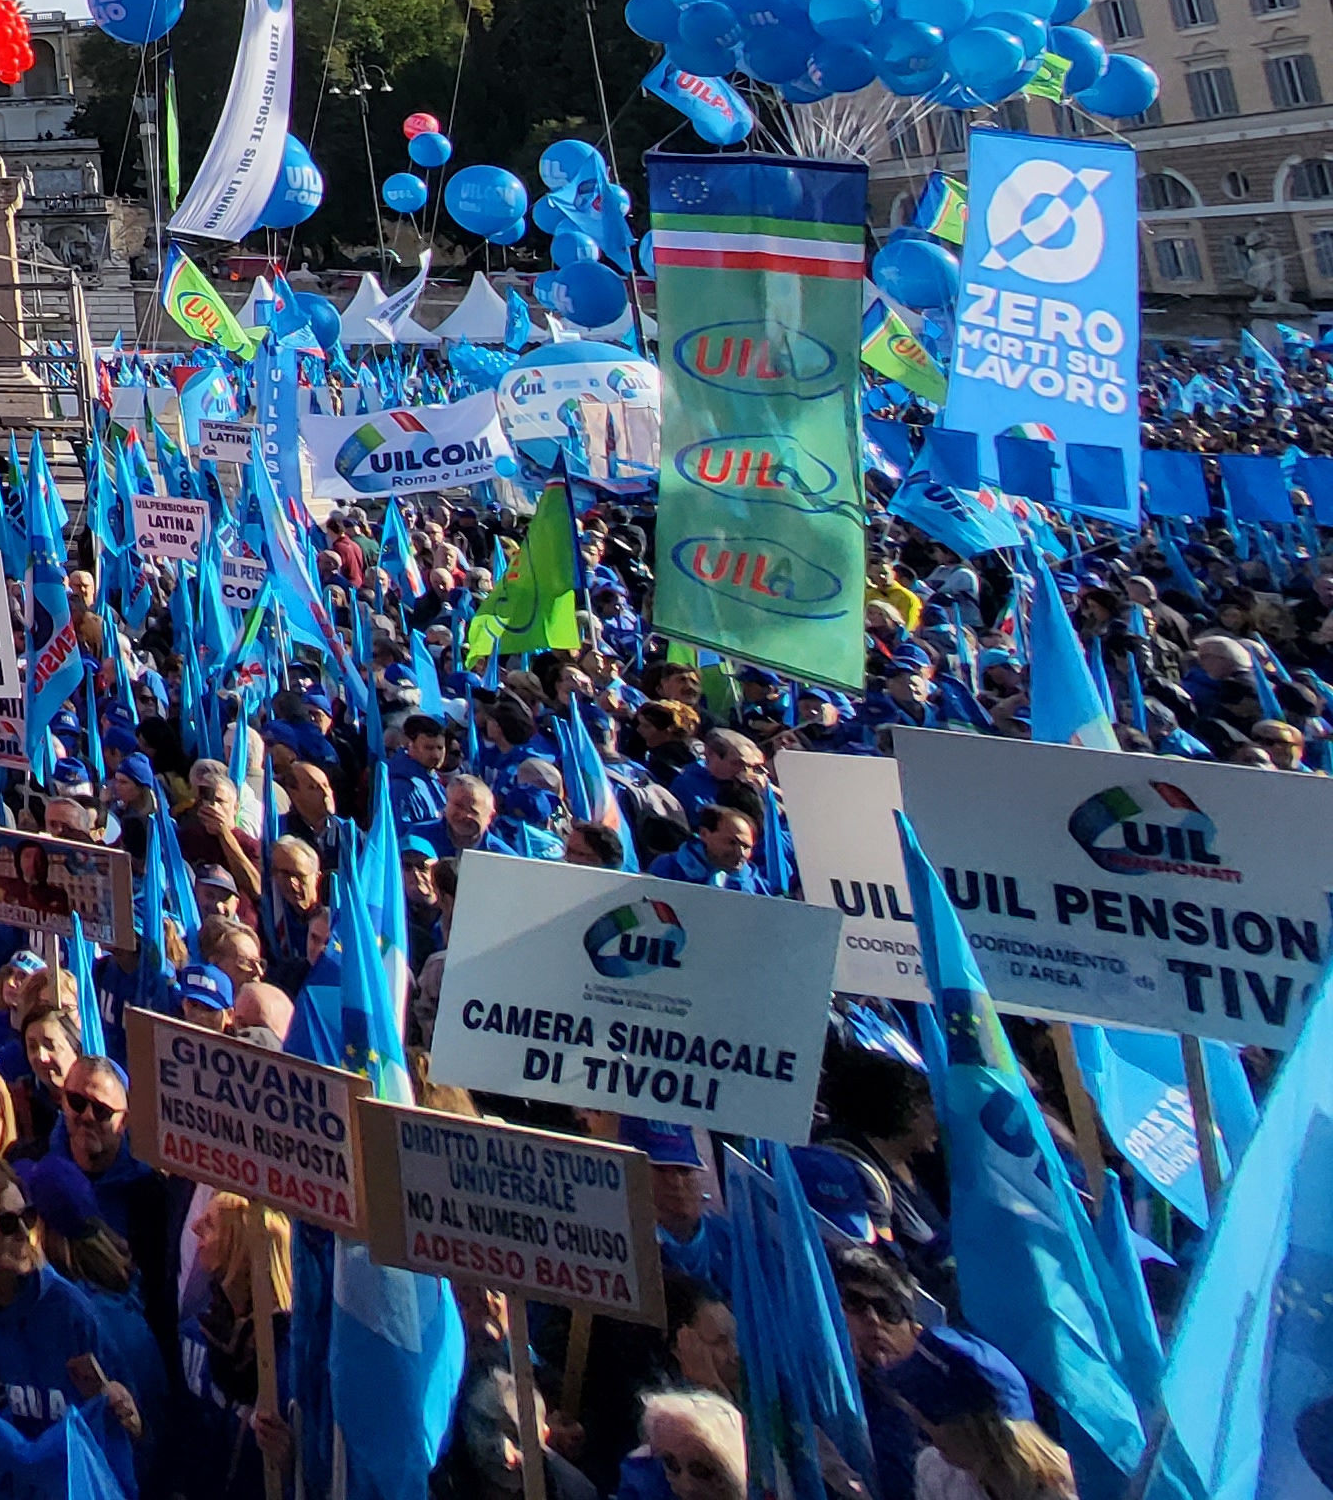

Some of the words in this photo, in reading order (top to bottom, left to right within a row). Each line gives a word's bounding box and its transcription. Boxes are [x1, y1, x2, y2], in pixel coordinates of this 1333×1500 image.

[269, 23, 280, 63] ZERO
[249, 68, 278, 144] RISPOSTE
[235, 148, 257, 174] SUL
[286, 165, 322, 190] UIL
[203, 179, 244, 231] LAVORO
[184, 295, 220, 336] UIL
[960, 284, 1123, 357] ZERO
[622, 377, 652, 390] UIL
[959, 329, 1060, 369] MORTI
[1066, 351, 1122, 386] SUL
[520, 382, 547, 396] UIL
[957, 354, 1126, 414] LAVORO
[208, 431, 252, 445] LATINA
[370, 436, 493, 474] UILCOM
[391, 474, 438, 489] Roma
[440, 471, 451, 481] e
[148, 514, 195, 533] LATINA
[159, 532, 187, 546] NORD
[1120, 820, 1221, 866] UIL
[830, 878, 914, 923] UIL
[943, 866, 1037, 921] UIL
[617, 933, 683, 970] UIL
[1010, 962, 1083, 990] D'AREA
[462, 998, 594, 1050] CAMERA
[607, 1017, 798, 1086] SINDACALE
[170, 1034, 329, 1109] GIOVANI
[523, 1048, 572, 1084] DI
[582, 1055, 720, 1113] TIVOLI
[158, 1059, 180, 1089] E
[193, 1066, 347, 1144] LAVORO
[159, 1097, 248, 1150] NESSUNA
[252, 1121, 351, 1185] RISPOSTA
[399, 1119, 480, 1164] DIRITTO
[486, 1136, 536, 1175] ALLO
[542, 1149, 621, 1193] STUDIO
[162, 1131, 259, 1189] ADESSO
[267, 1162, 351, 1220] BASTA
[448, 1157, 577, 1216] UNIVERSALE
[406, 1188, 434, 1222] NO
[439, 1195, 462, 1228] AL
[466, 1200, 549, 1249] NUMERO
[553, 1218, 628, 1265] CHIUSO
[412, 1228, 527, 1279] ADESSO
[536, 1256, 633, 1304] BASTA
